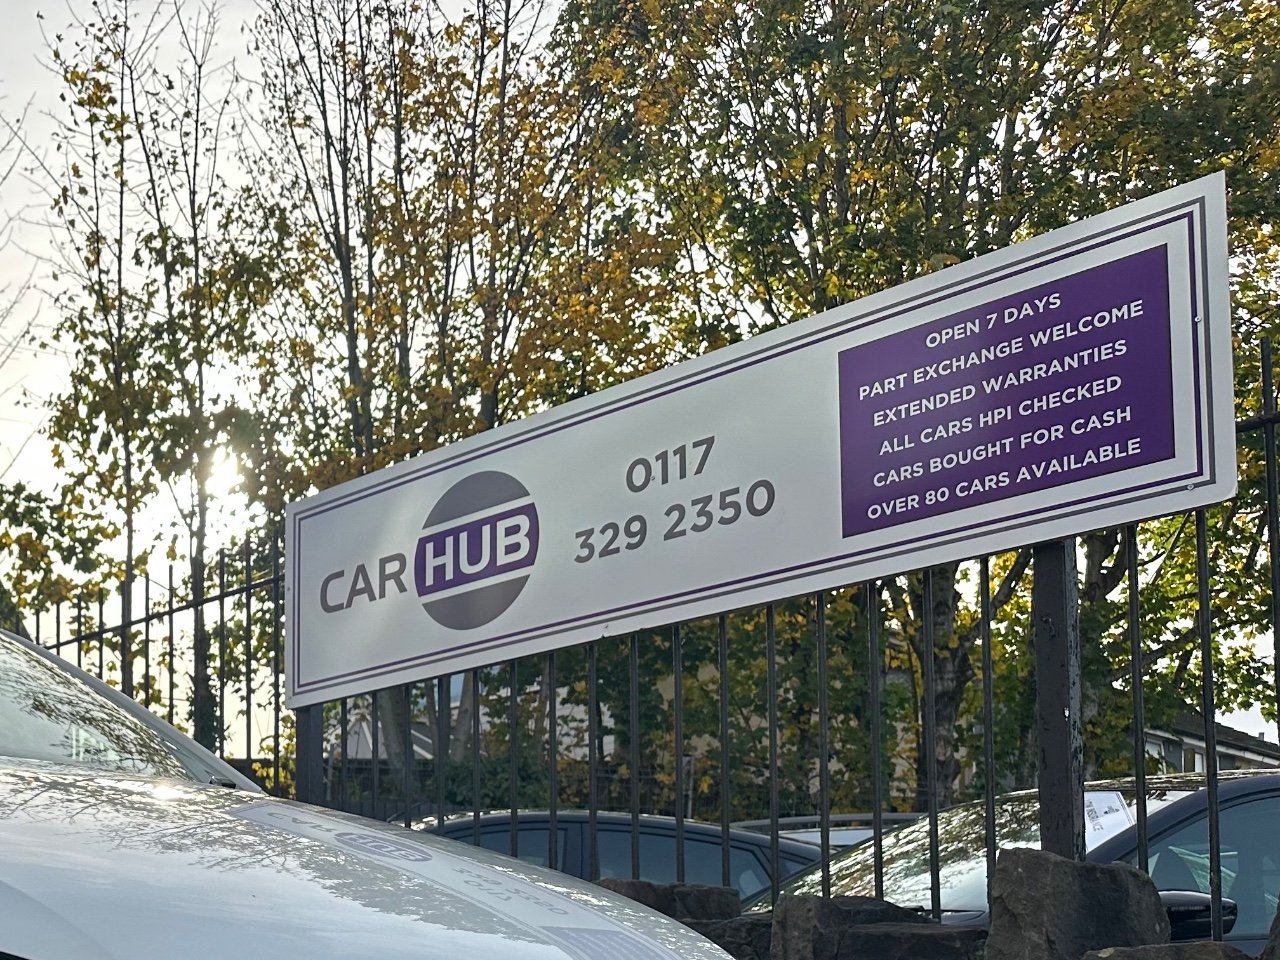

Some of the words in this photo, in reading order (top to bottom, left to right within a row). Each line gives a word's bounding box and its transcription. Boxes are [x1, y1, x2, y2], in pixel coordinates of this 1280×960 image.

[858, 373, 908, 401] PART
[913, 337, 1023, 384] EXCHANGE
[1029, 300, 1144, 347] WELCOME
[925, 319, 980, 348] OPEN
[986, 313, 998, 330] 7
[1004, 293, 1062, 324] DAYS
[873, 385, 976, 427] EXTENDED
[982, 339, 1127, 394] WARRANTIES
[879, 434, 915, 456] ALL
[920, 417, 973, 444] CARS
[979, 405, 1013, 428] HPI
[1018, 375, 1122, 416] CHECKED
[625, 435, 716, 493] 0117
[867, 494, 920, 519] OVER
[925, 487, 950, 506] 80
[955, 471, 1010, 498] CARS
[1015, 437, 1141, 484] AVAILABLE
[873, 462, 923, 487] CARS
[929, 437, 1014, 473] BOUGHT
[1020, 424, 1064, 449] FOR
[1070, 406, 1131, 435] CASH
[573, 514, 648, 564] 329
[663, 479, 776, 542] 2350
[319, 552, 408, 615] CAR
[424, 514, 531, 587] HUB
